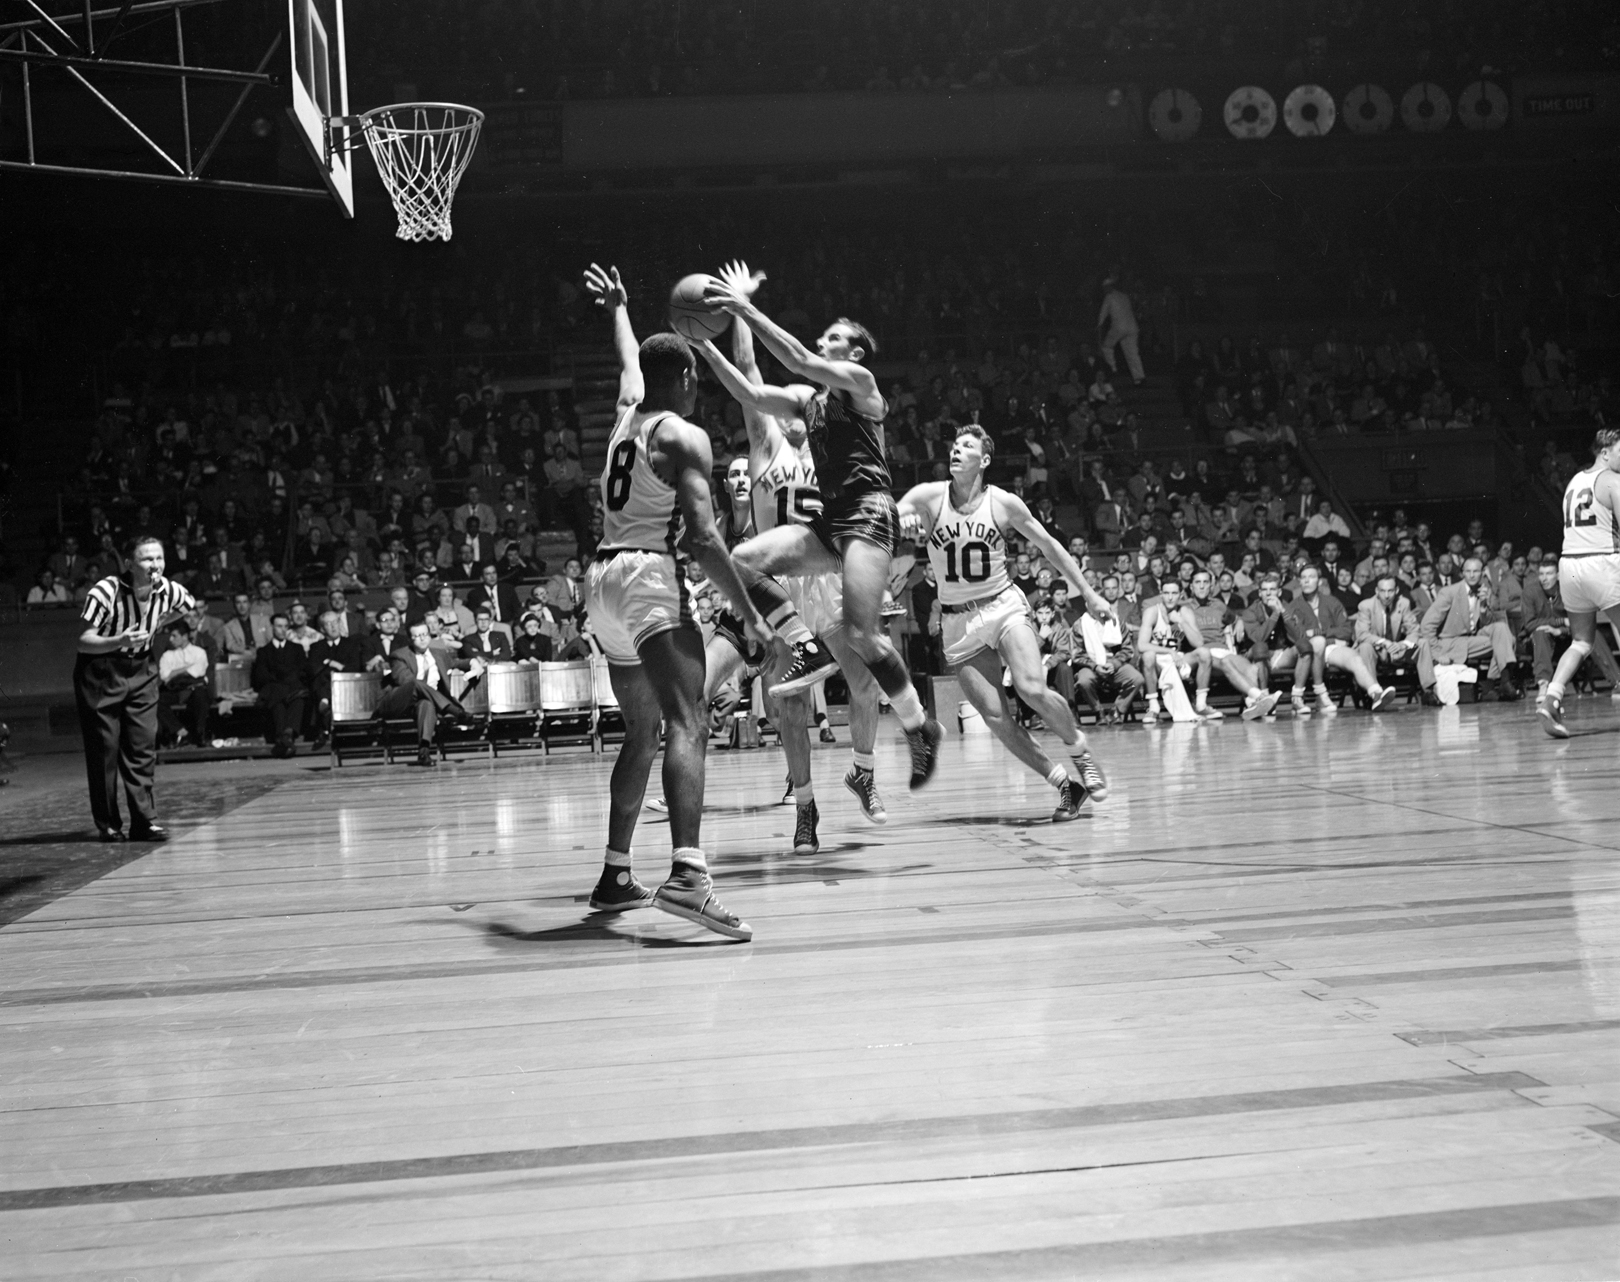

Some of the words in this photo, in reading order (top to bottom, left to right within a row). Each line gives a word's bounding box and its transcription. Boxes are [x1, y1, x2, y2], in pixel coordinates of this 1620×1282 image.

[1528, 99, 1562, 113] TIME
[1565, 97, 1590, 111] OUT
[606, 439, 637, 511] 8
[761, 466, 796, 494] NEW
[802, 467, 819, 486] YO
[774, 486, 822, 527] 15
[1564, 487, 1597, 529] 12
[930, 522, 961, 550] NEW
[965, 521, 1001, 551] YORK
[943, 541, 991, 583] 10
